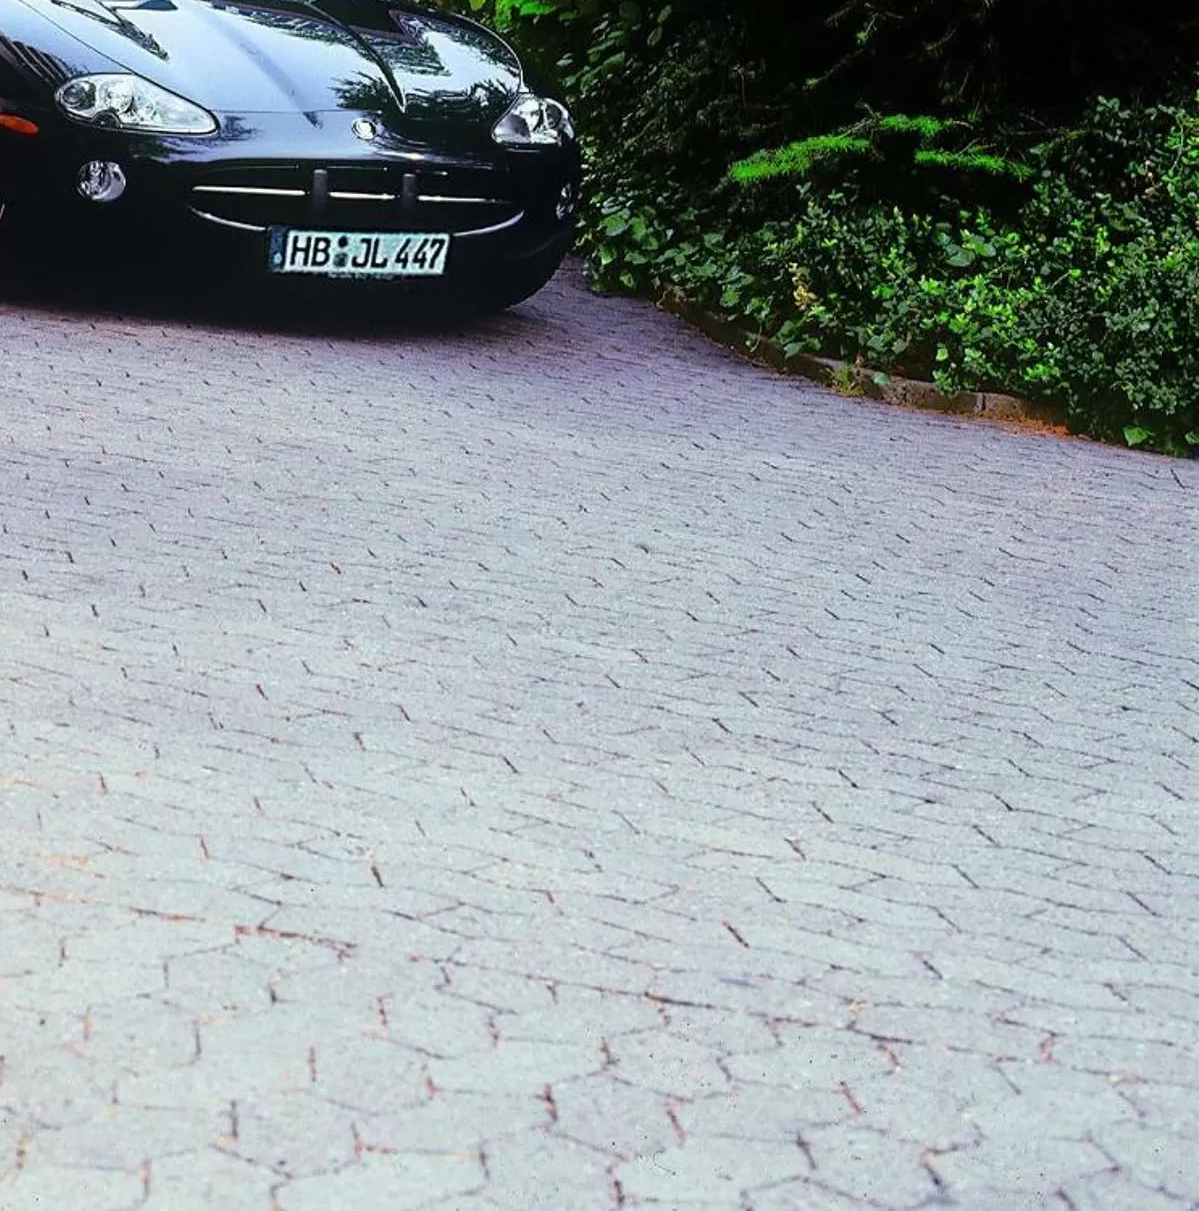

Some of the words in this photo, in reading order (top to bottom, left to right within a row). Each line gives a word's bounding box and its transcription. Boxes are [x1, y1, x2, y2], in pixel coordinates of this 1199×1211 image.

[289, 235, 331, 267] HB
[351, 237, 388, 269] JL
[394, 237, 446, 270] 447
